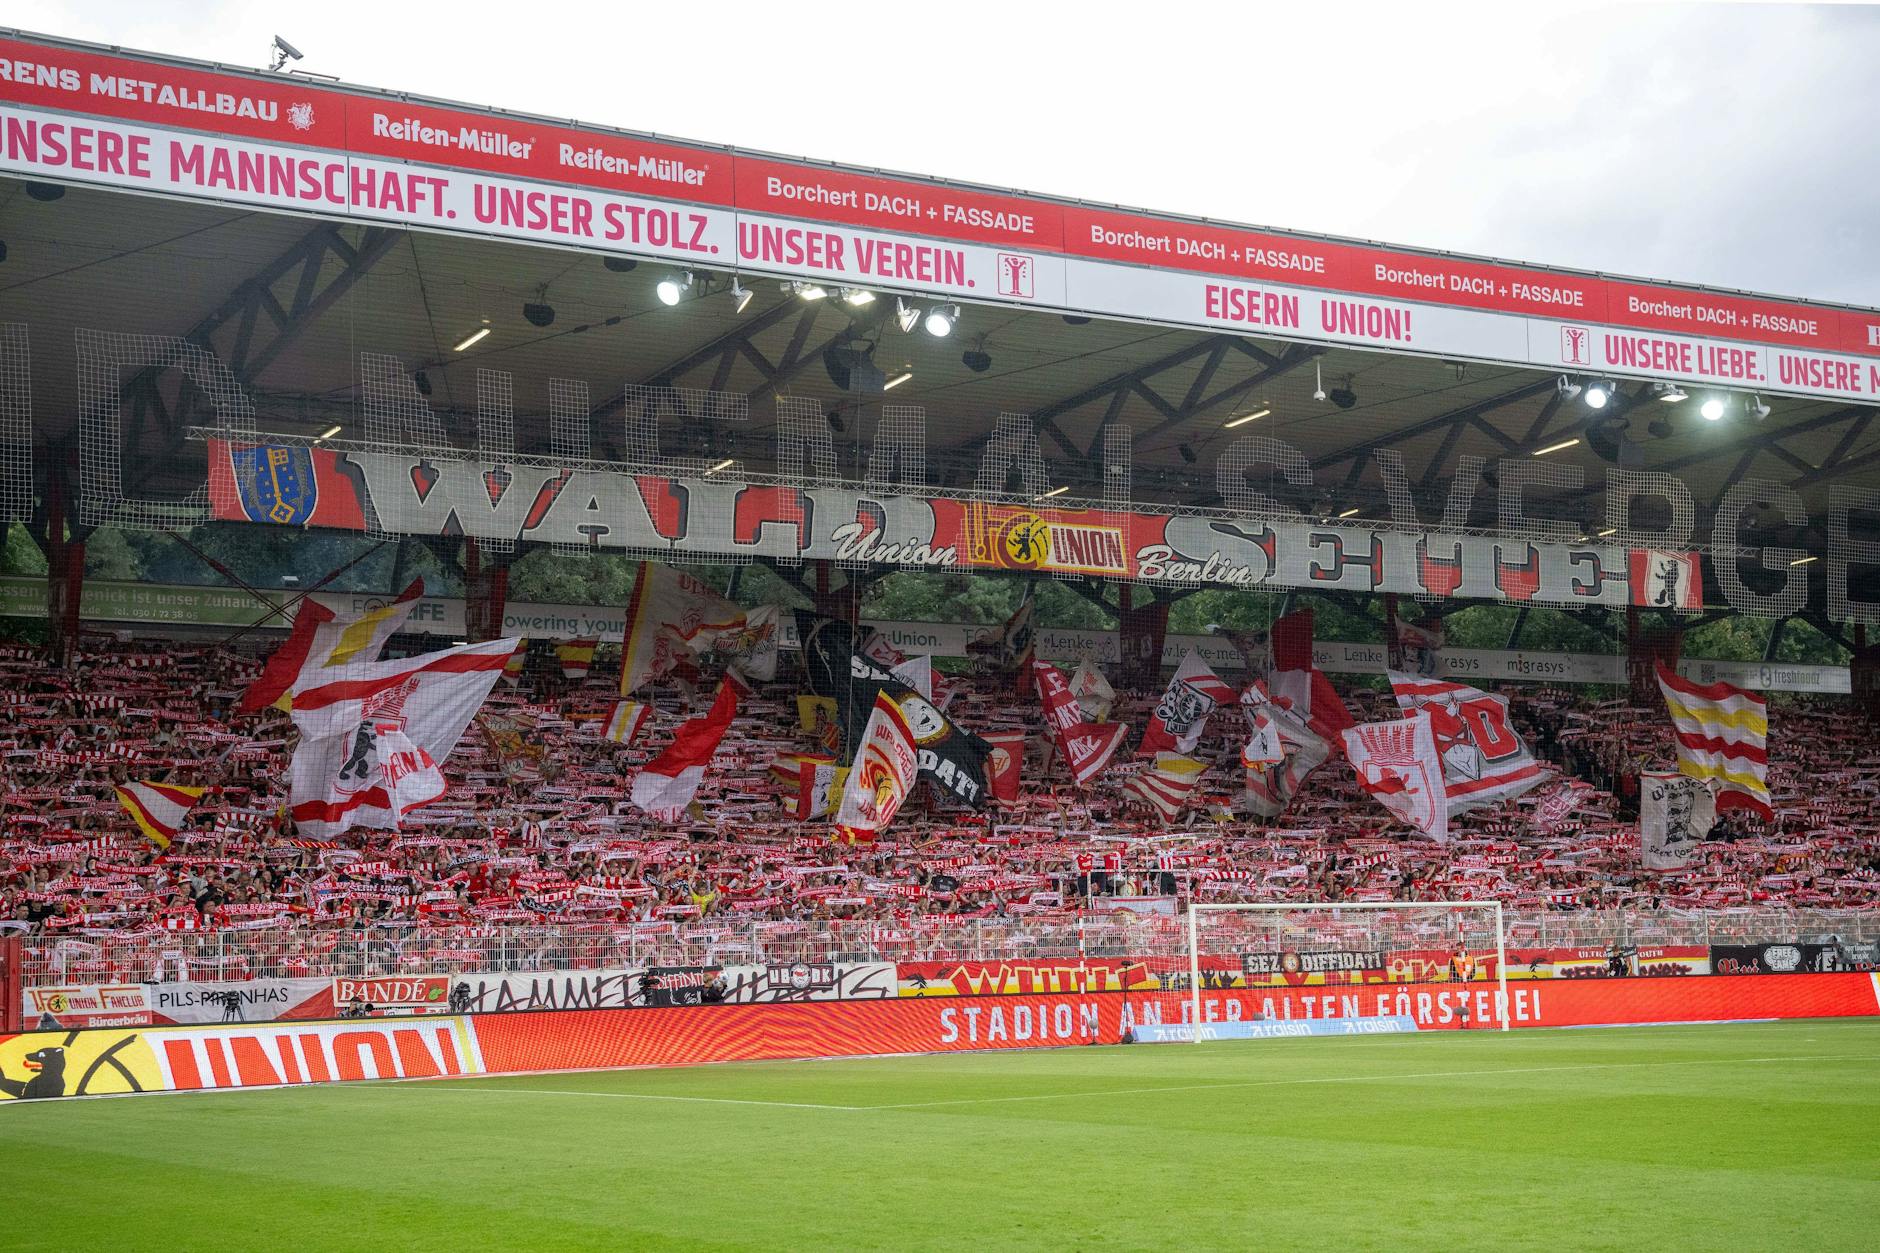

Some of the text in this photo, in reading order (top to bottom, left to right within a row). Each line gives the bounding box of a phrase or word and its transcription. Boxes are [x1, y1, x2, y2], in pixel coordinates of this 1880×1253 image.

[90, 73, 278, 122] METALLBAU
[0, 115, 719, 254] NSERE MANNSCHAFT. UNSER STOLZ.
[767, 176, 1034, 234] Borchert DACH + FASSADE
[739, 221, 976, 288] UNSER VEREIN.
[1091, 224, 1325, 274] Borchert DACH + FASSADE
[1375, 263, 1584, 307] Borchert DACH + FASSADE
[1205, 284, 1412, 342] EISERN UNION!
[1628, 295, 1818, 336] Borchert DACH + FASSADE
[1605, 333, 1692, 373] UNSERE
[1697, 345, 1766, 382] LIEBE.
[1778, 354, 1861, 393] UNSERE
[345, 452, 1633, 604] WALD SEITE
[832, 522, 958, 567] Union
[1052, 526, 1127, 569] UNION
[1136, 542, 1252, 586] Berlin
[157, 594, 200, 607] unser
[505, 613, 578, 634] owering
[1050, 635, 1095, 650] Lenke
[1344, 647, 1382, 663] Lenke
[1507, 654, 1564, 673] migrasys
[340, 978, 427, 1003] BANDÉ
[940, 1003, 1099, 1043] STADION
[1355, 1016, 1401, 1034] raisin
